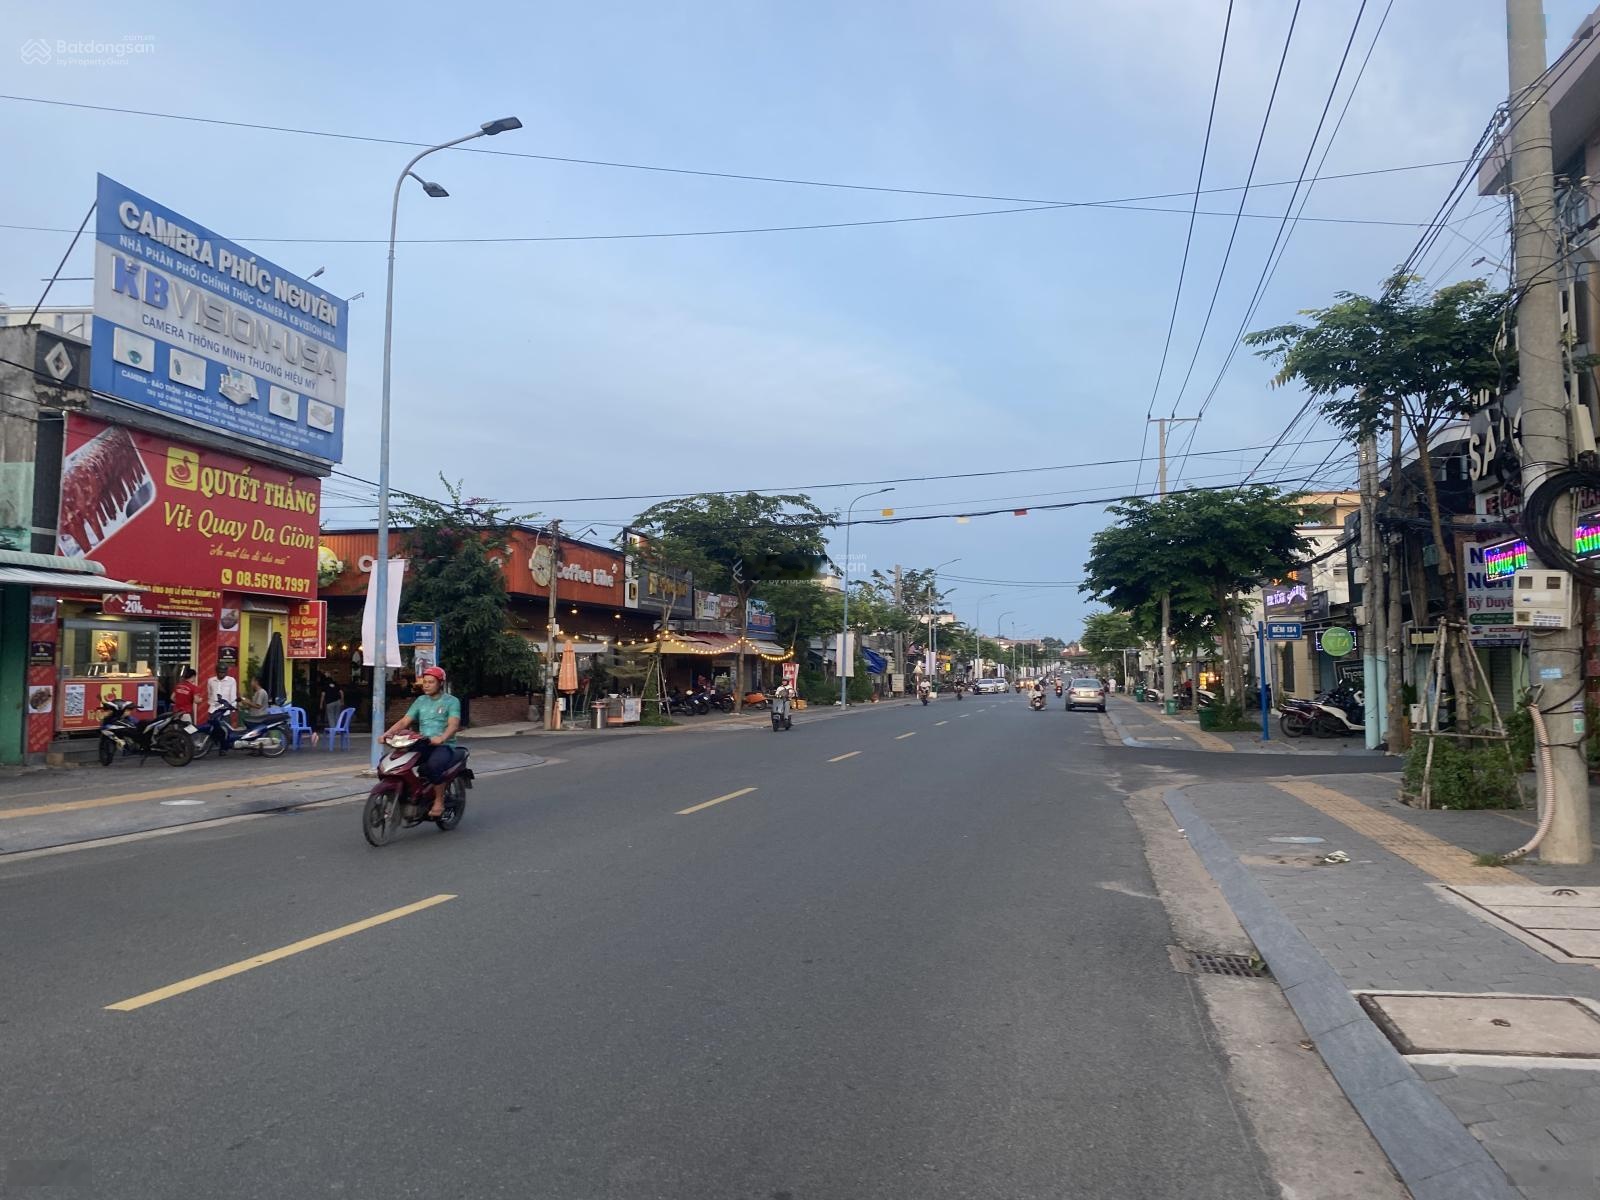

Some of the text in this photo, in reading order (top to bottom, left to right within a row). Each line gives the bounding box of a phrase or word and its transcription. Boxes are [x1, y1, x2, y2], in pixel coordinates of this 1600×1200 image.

[119, 201, 337, 328] CAMERA PHÚC NGUYÊN
[120, 235, 142, 254] NHÀ
[145, 247, 173, 268] PHÂN
[176, 261, 200, 280] PHỐI
[201, 273, 230, 294] CHÍNH
[232, 286, 255, 305] THỨC
[256, 298, 288, 320] CAMERA
[142, 314, 184, 339] CAMERA
[188, 331, 220, 353] THÔNG
[222, 345, 246, 362] MINH
[284, 368, 303, 386] HIỆU
[200, 464, 317, 515] QUYẾT THẮNG
[164, 501, 315, 550] Vịt Quay Da Giòn
[236, 570, 310, 593] 08.5678.7997
